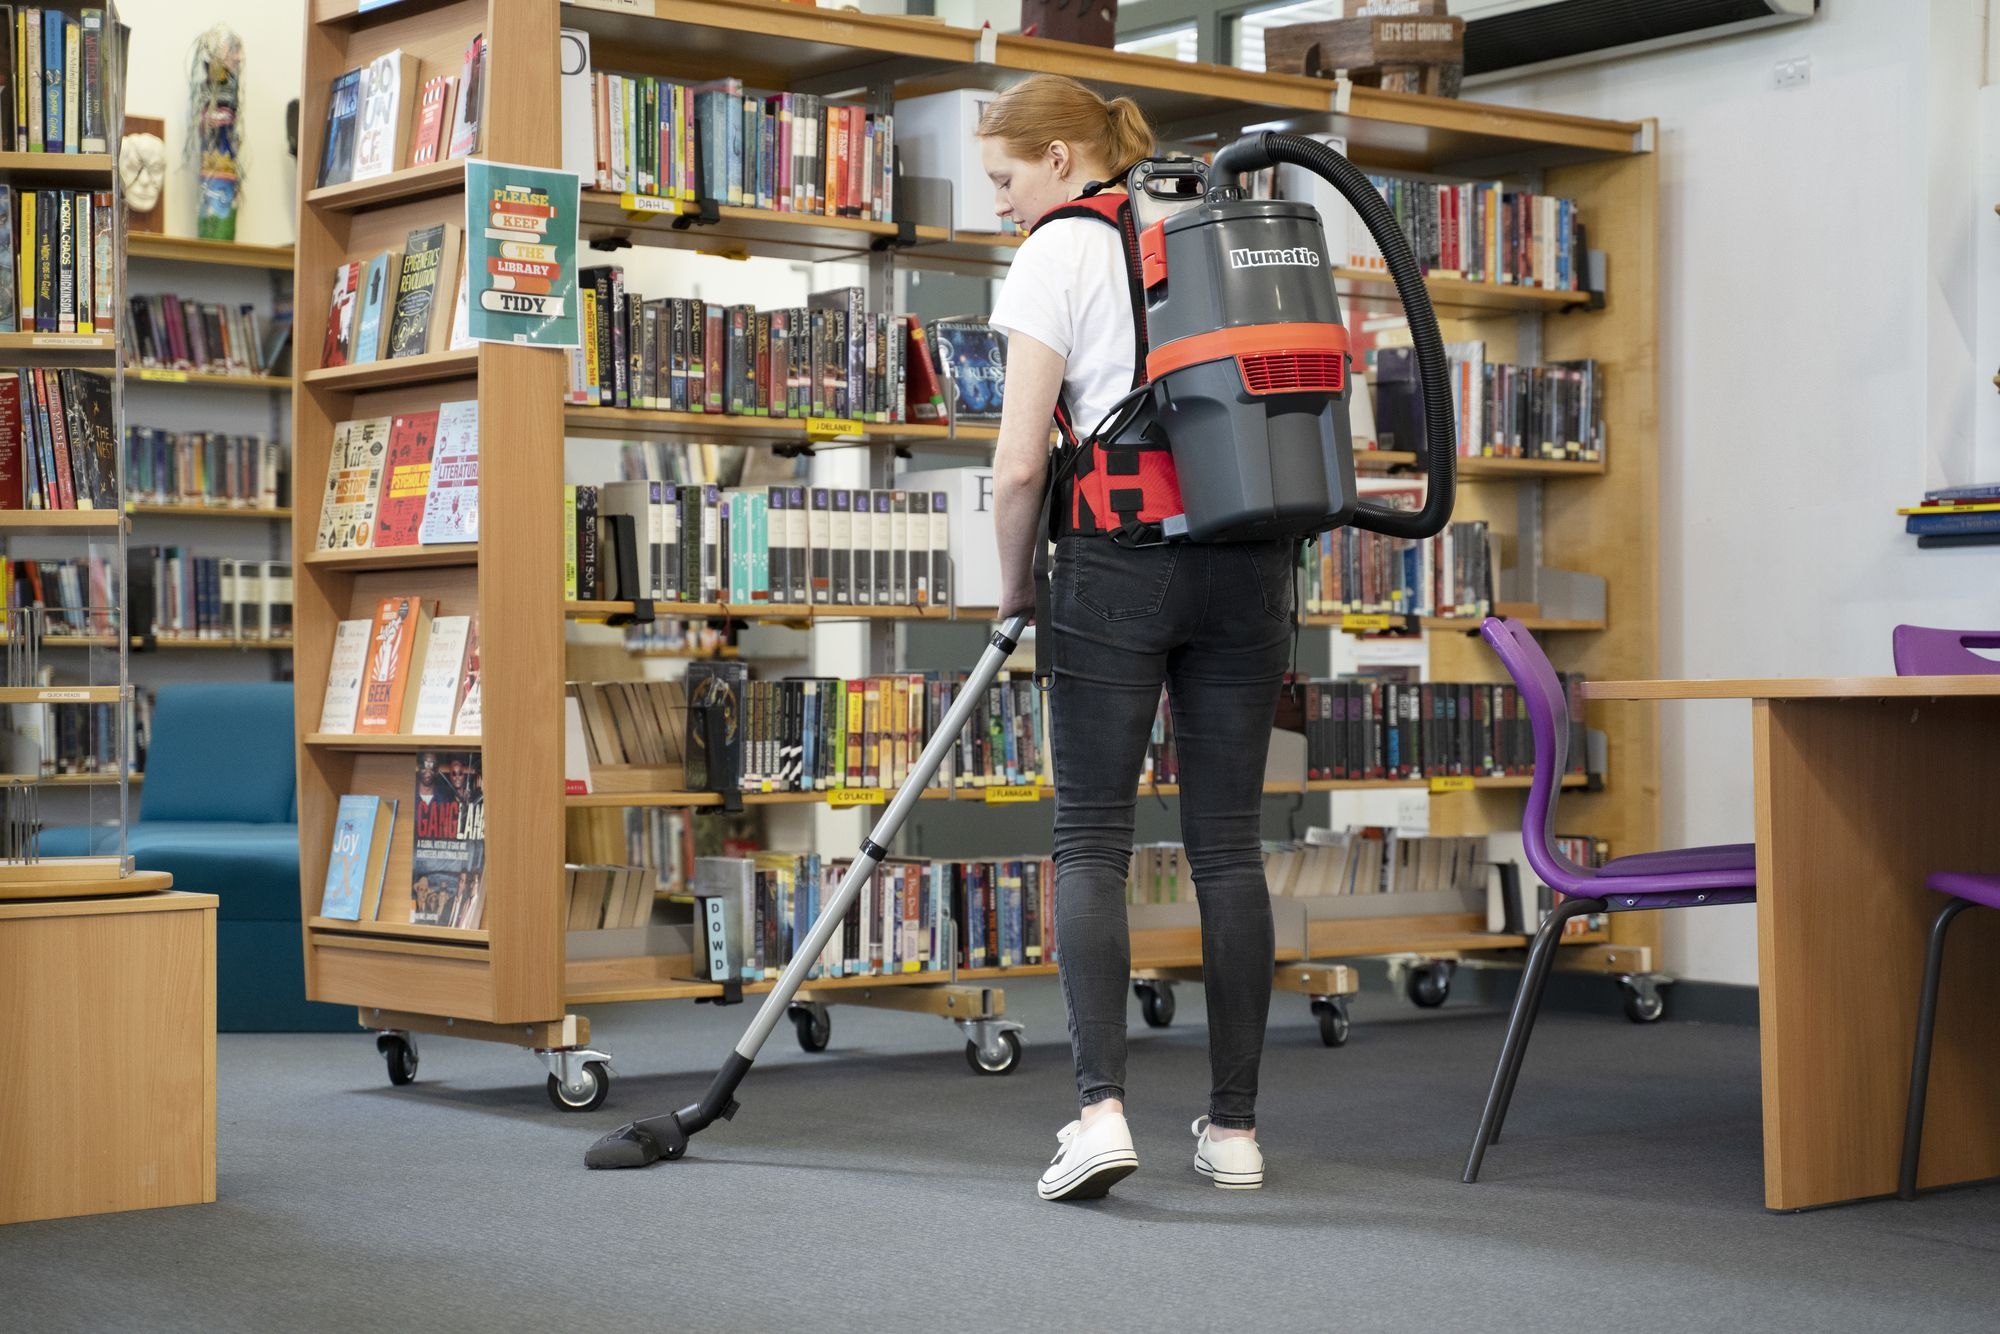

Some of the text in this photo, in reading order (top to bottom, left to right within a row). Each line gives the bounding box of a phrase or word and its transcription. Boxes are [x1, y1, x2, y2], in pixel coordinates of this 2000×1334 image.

[1381, 22, 1402, 41] LET'S
[1403, 22, 1416, 41] GET
[494, 189, 549, 206] PLEASE
[638, 199, 670, 211] DAHL
[503, 215, 539, 229] KEEP
[61, 199, 71, 265] MORTAL CHAOS
[403, 248, 440, 273] EPIGENETICS
[515, 245, 545, 260] THE
[1229, 247, 1320, 268] Numatic
[497, 260, 550, 276] LIBRARY
[400, 268, 436, 293] REVOLUTION
[61, 274, 72, 313] DICKINSON
[500, 294, 546, 313] TIDY
[587, 347, 596, 365] dog
[52, 410, 65, 449] MOOSE
[95, 425, 110, 439] THE
[820, 423, 852, 432] DELANEY
[95, 440, 114, 460] NEST
[585, 515, 595, 588] SEVENTH SON
[417, 799, 485, 840] GANGLAN
[333, 828, 359, 857] Joy
